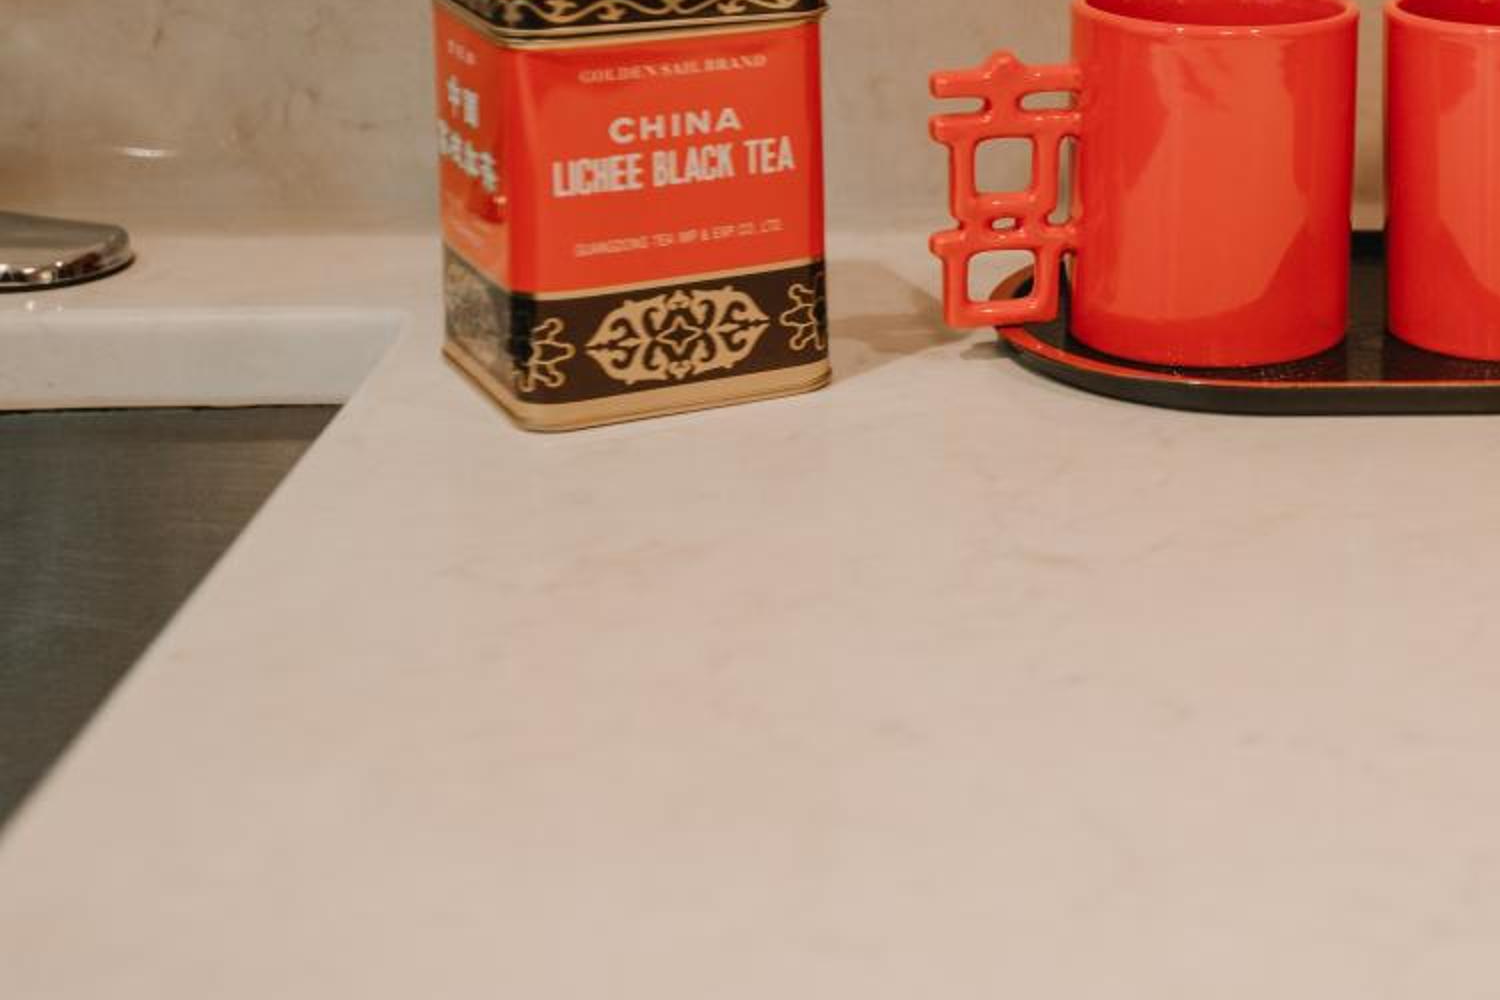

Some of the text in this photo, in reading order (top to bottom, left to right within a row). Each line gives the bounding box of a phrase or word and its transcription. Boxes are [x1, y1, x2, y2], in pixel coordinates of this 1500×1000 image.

[577, 53, 768, 84] GOLDEN SAIL BRAND
[608, 107, 742, 144] CHINA
[552, 135, 796, 198] LICHEE BLACK TEA
